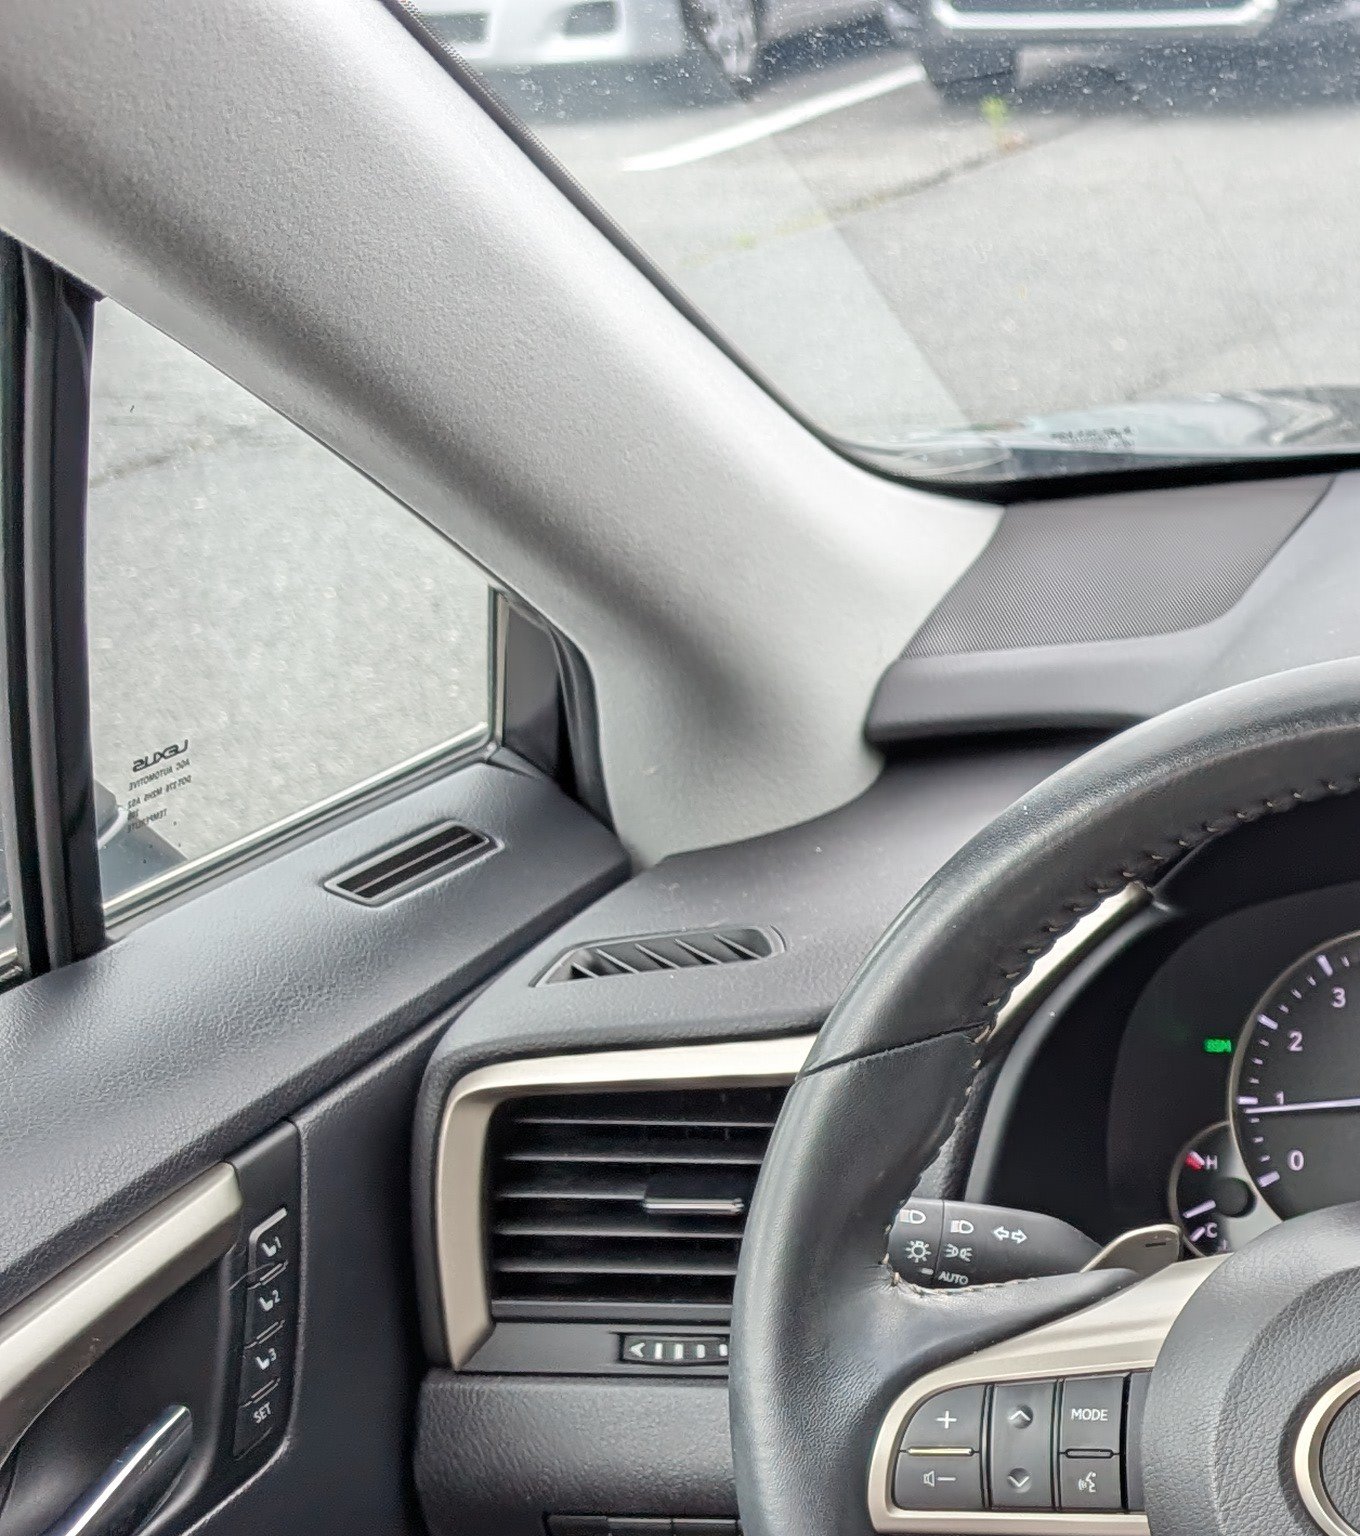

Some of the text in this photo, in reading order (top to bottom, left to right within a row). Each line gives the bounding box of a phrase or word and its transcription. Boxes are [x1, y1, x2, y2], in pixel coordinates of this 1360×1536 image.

[1332, 987, 1346, 1008] 3
[1288, 1031, 1303, 1052] 2
[1275, 1091, 1285, 1106] 1
[1206, 1155, 1218, 1170] H
[1287, 1150, 1305, 1171] 0
[1206, 1222, 1218, 1238] C
[274, 1236, 282, 1250] 1
[938, 1271, 969, 1286] AUTO
[271, 1289, 281, 1303] 2
[269, 1348, 278, 1362] 3
[253, 1402, 272, 1424] SET
[1071, 1407, 1109, 1422] MODE
